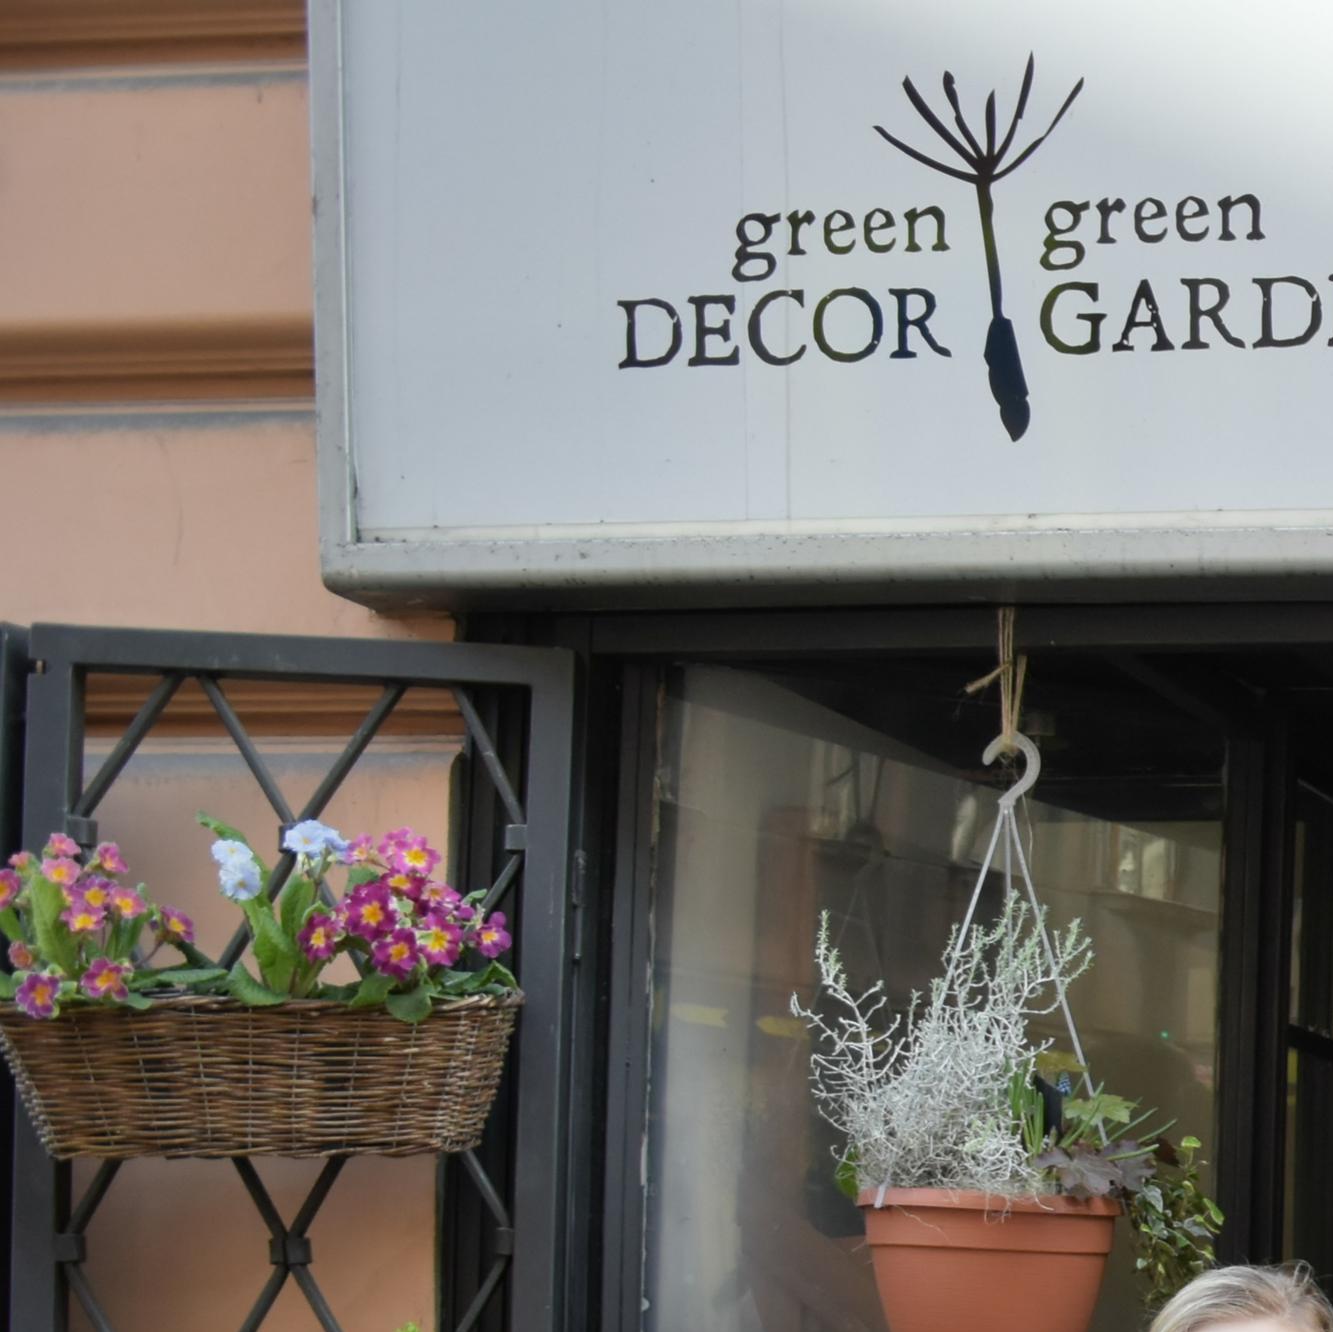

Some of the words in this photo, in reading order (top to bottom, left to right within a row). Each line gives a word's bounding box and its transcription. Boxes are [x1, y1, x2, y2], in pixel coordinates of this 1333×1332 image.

[731, 205, 951, 283] green
[1038, 192, 1266, 271] green
[617, 286, 953, 370] DECOR
